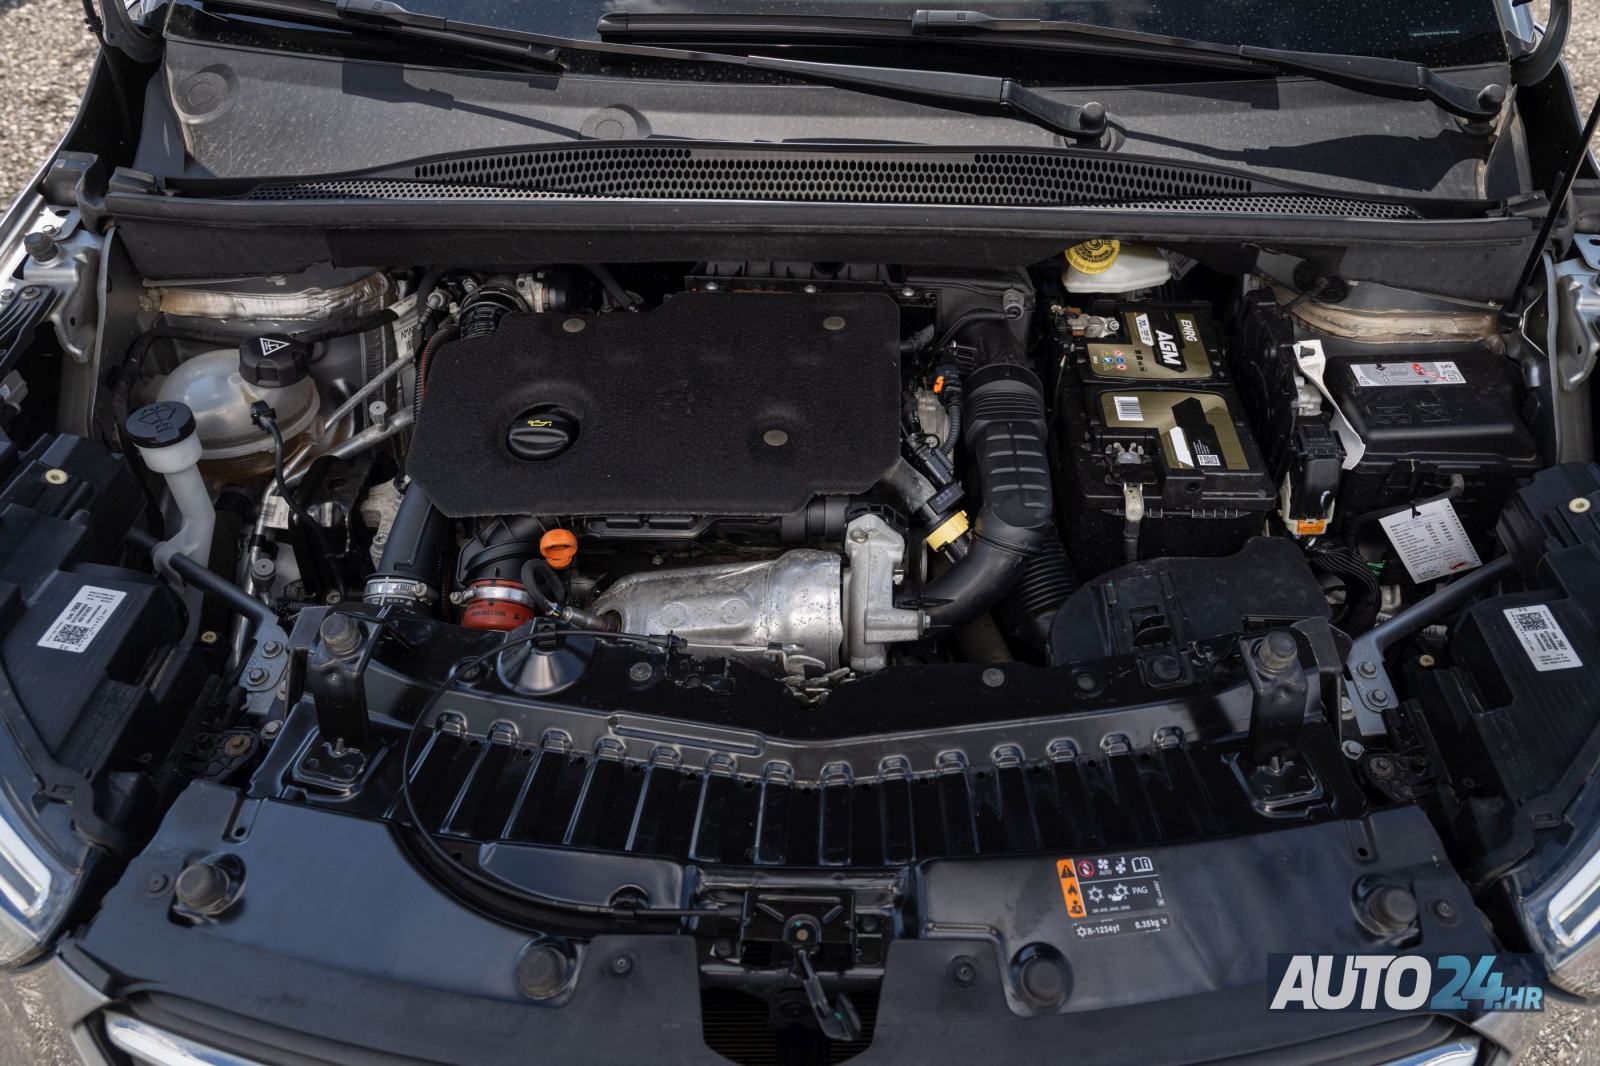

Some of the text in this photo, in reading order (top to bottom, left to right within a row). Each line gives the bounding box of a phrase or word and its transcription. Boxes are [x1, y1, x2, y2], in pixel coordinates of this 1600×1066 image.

[1180, 319, 1198, 342] ENRG
[1155, 329, 1182, 365] AGM
[1131, 885, 1149, 895] PAG
